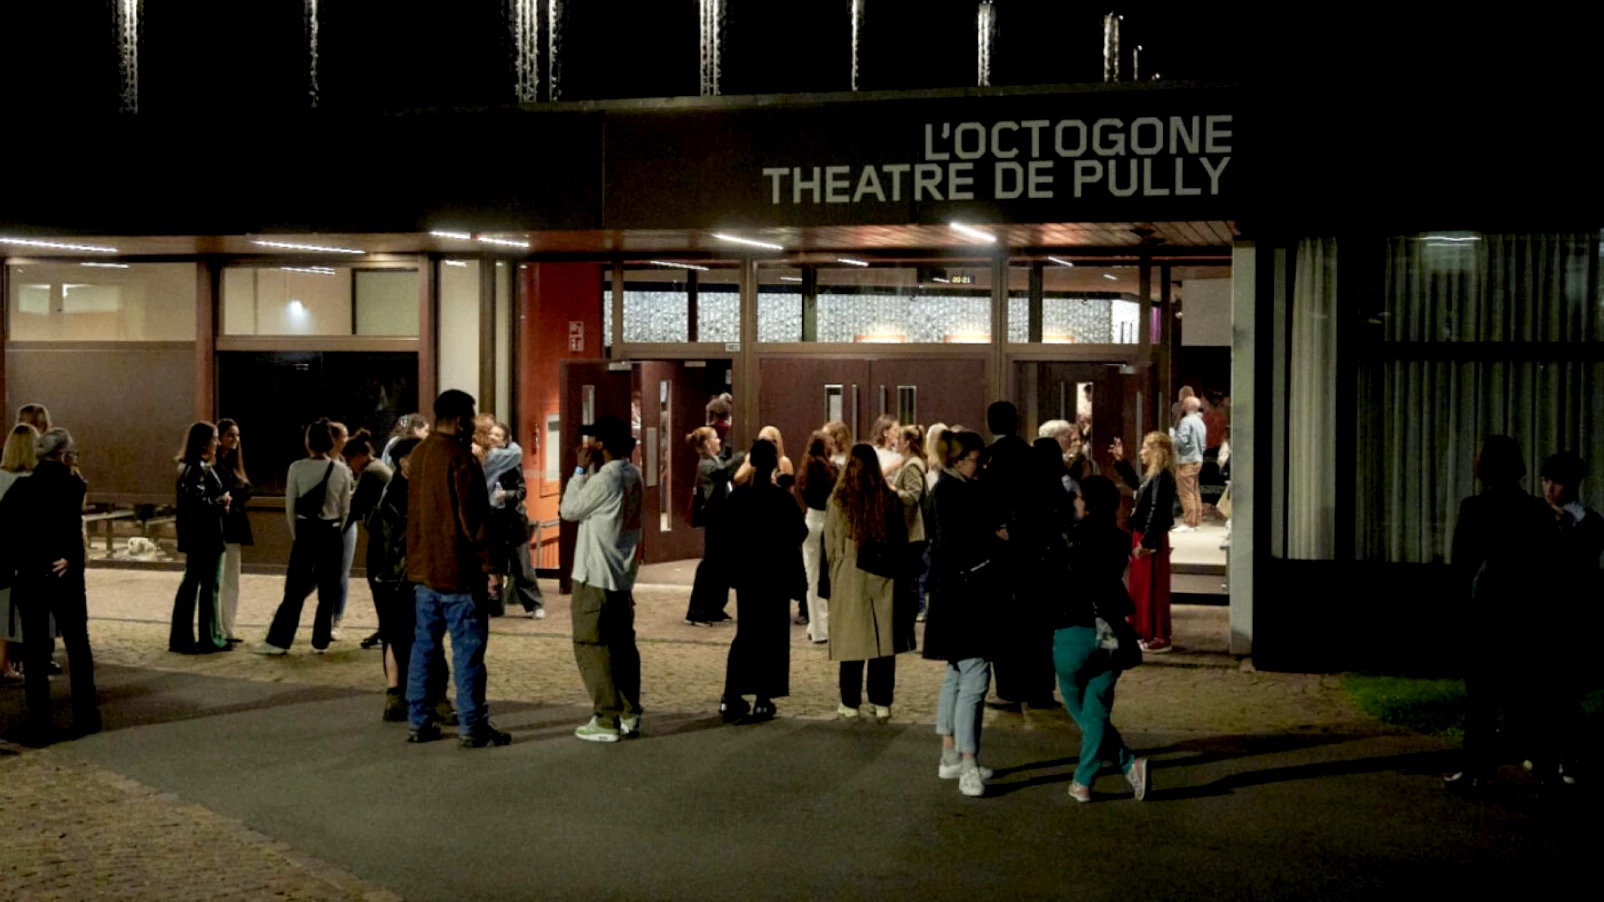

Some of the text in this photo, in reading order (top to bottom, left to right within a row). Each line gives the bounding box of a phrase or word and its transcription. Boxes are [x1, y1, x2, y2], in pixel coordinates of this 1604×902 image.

[924, 115, 1233, 160] L'OCTOGONE
[762, 156, 1232, 205] THEATRE DE PULLY
